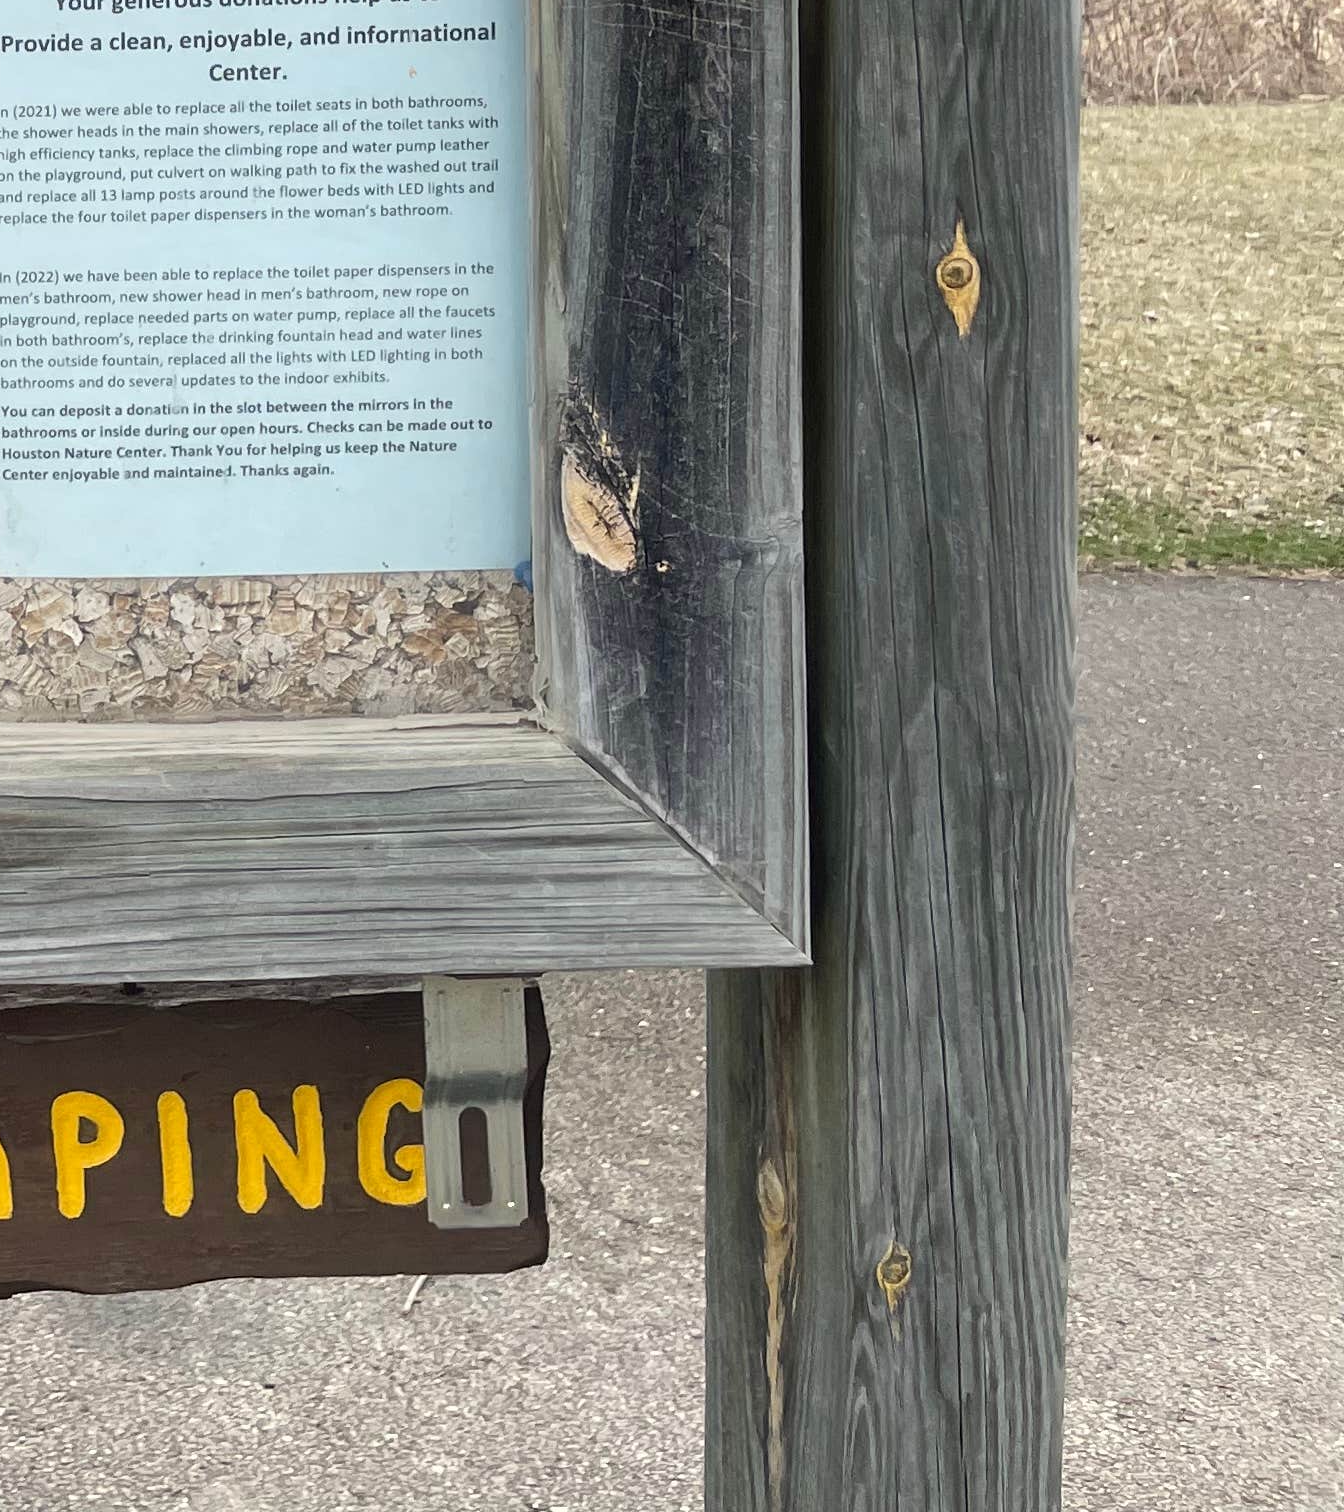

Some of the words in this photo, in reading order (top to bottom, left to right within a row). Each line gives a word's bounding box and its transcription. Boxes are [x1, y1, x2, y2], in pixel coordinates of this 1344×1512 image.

[1, 32, 84, 54] Provide
[89, 37, 102, 52] a
[108, 31, 173, 54] clean,
[179, 27, 293, 54] enjoyable,
[299, 25, 341, 47] and
[346, 21, 497, 45] informational
[208, 63, 288, 82] Center.
